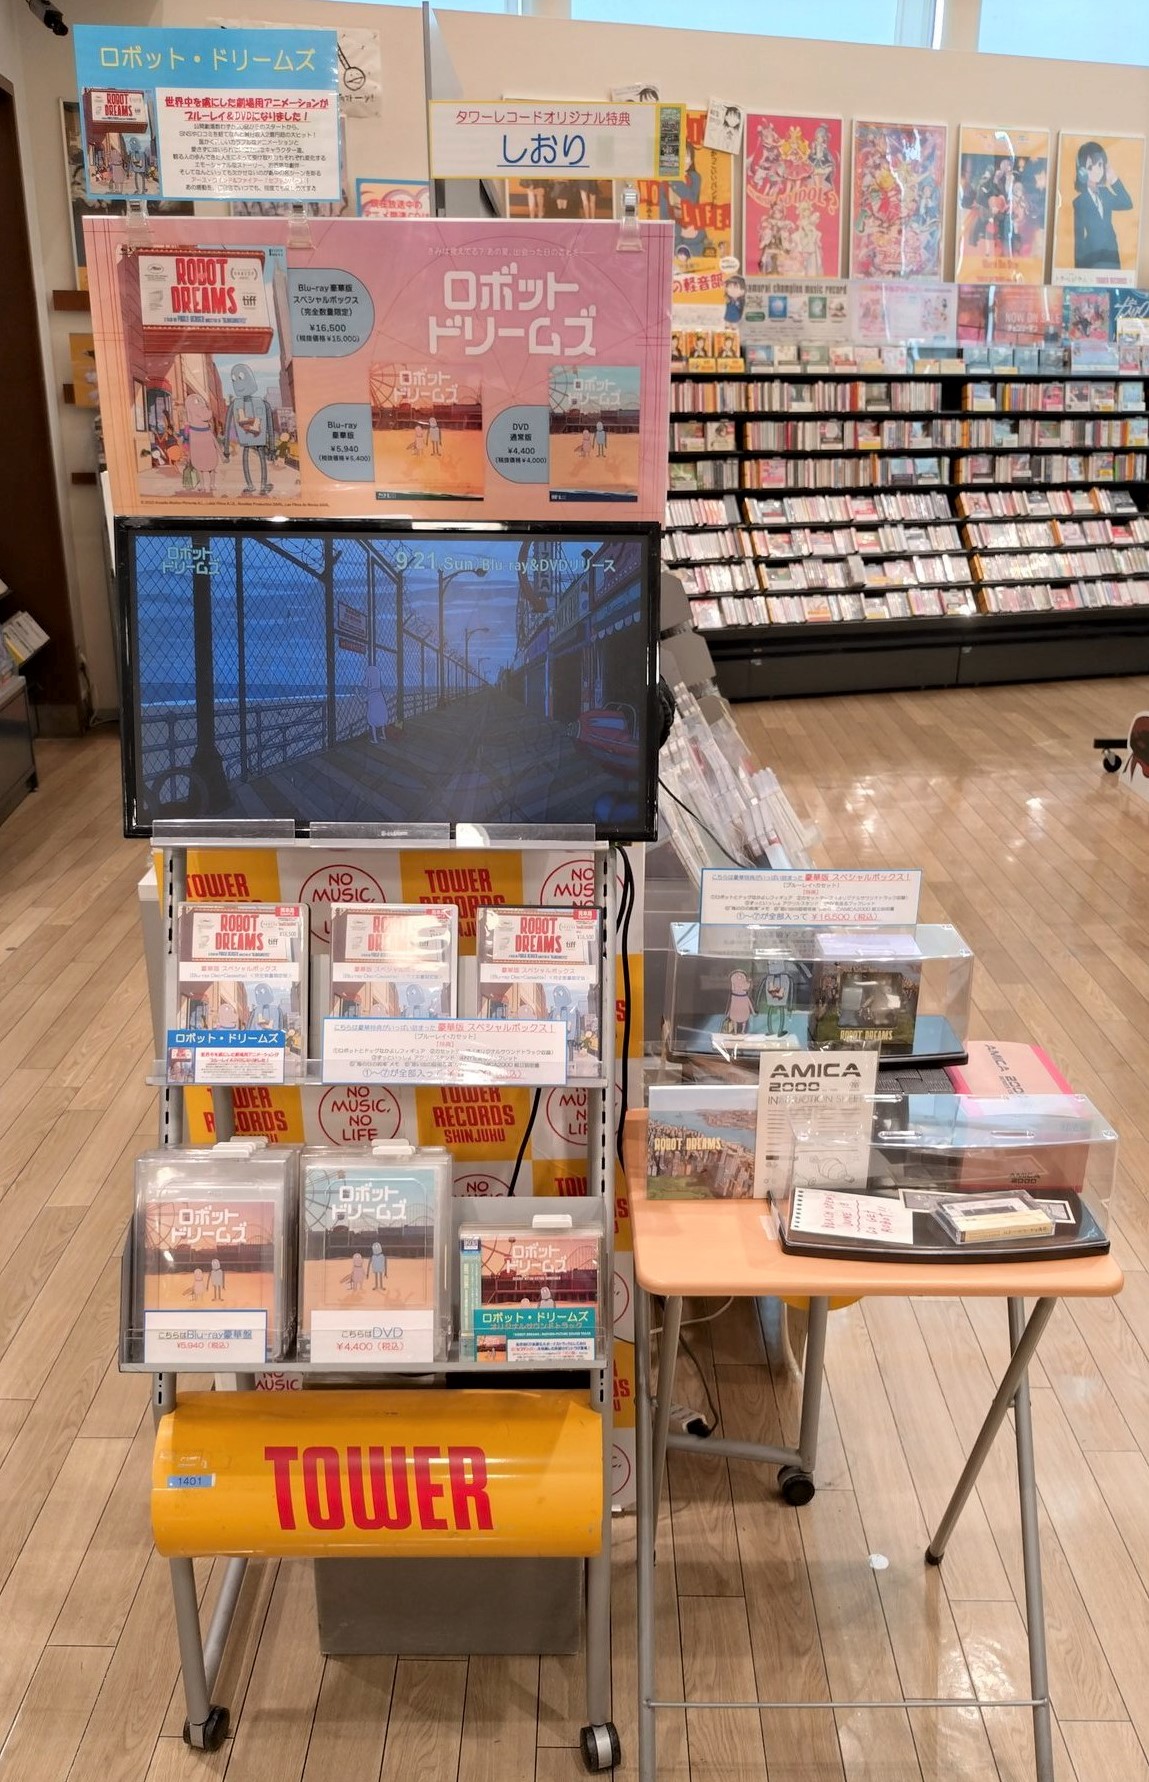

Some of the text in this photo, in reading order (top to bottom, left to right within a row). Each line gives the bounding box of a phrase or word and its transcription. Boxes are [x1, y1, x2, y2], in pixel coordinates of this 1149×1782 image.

[100, 45, 316, 71] ロボット・ドリームズ
[455, 110, 631, 125] タワーレコードオリジナル特典
[501, 133, 587, 165] しおり
[175, 257, 228, 286] ROBOT
[298, 284, 330, 292] Blu-ray
[443, 262, 579, 311] ロボット
[170, 286, 238, 314] DREAMS
[242, 295, 257, 306] tiff
[293, 296, 359, 304] スペシャルボックス
[309, 324, 347, 332] ¥16,500
[428, 304, 597, 356] ドリームズ
[399, 368, 451, 386] ロボット
[572, 375, 616, 392] ロボット
[393, 384, 459, 404] ドリームズ
[567, 390, 621, 406] ドリームズ
[327, 421, 358, 430] Blu-ray
[512, 423, 530, 431] DVD
[330, 445, 359, 453] ¥5,940
[508, 447, 536, 455] ¥4,400
[167, 544, 214, 560] ロボット
[162, 558, 221, 575] ドリームズ
[329, 873, 353, 886] NO
[424, 868, 492, 894] TOWER
[571, 868, 594, 881] NO
[312, 888, 376, 903] MUSIC,
[220, 914, 260, 932] ROBOT
[520, 917, 558, 935] ROBOT
[215, 932, 264, 951] DREAMS
[515, 935, 562, 953] DREAMS
[175, 1033, 278, 1044] ロボット・ドリームズ
[770, 1062, 862, 1078] AMICA
[347, 1086, 370, 1098] NO
[768, 1082, 820, 1092] 2000
[331, 1099, 391, 1113] MUSIC,
[349, 1114, 372, 1126] NO
[432, 1104, 516, 1128] RECORDS
[342, 1128, 378, 1141] LIFE
[444, 1128, 506, 1144] SHINJUKU
[654, 1137, 722, 1150] ROBOT DREAMS
[339, 1182, 399, 1202] ロボット
[466, 1180, 489, 1192] NO
[178, 1204, 240, 1226] ロボット
[331, 1198, 407, 1220] ドリームズ
[171, 1222, 248, 1244] ドリームズ
[512, 1242, 560, 1259] ロボット
[506, 1256, 567, 1274] ドリームズ
[482, 1310, 589, 1323] ロボット・ドリームズ
[342, 1326, 404, 1339] こちらはDVD
[336, 1341, 405, 1351] ¥4,400（税込）
[178, 1476, 202, 1486] 1401
[264, 1446, 494, 1530] TOWER
